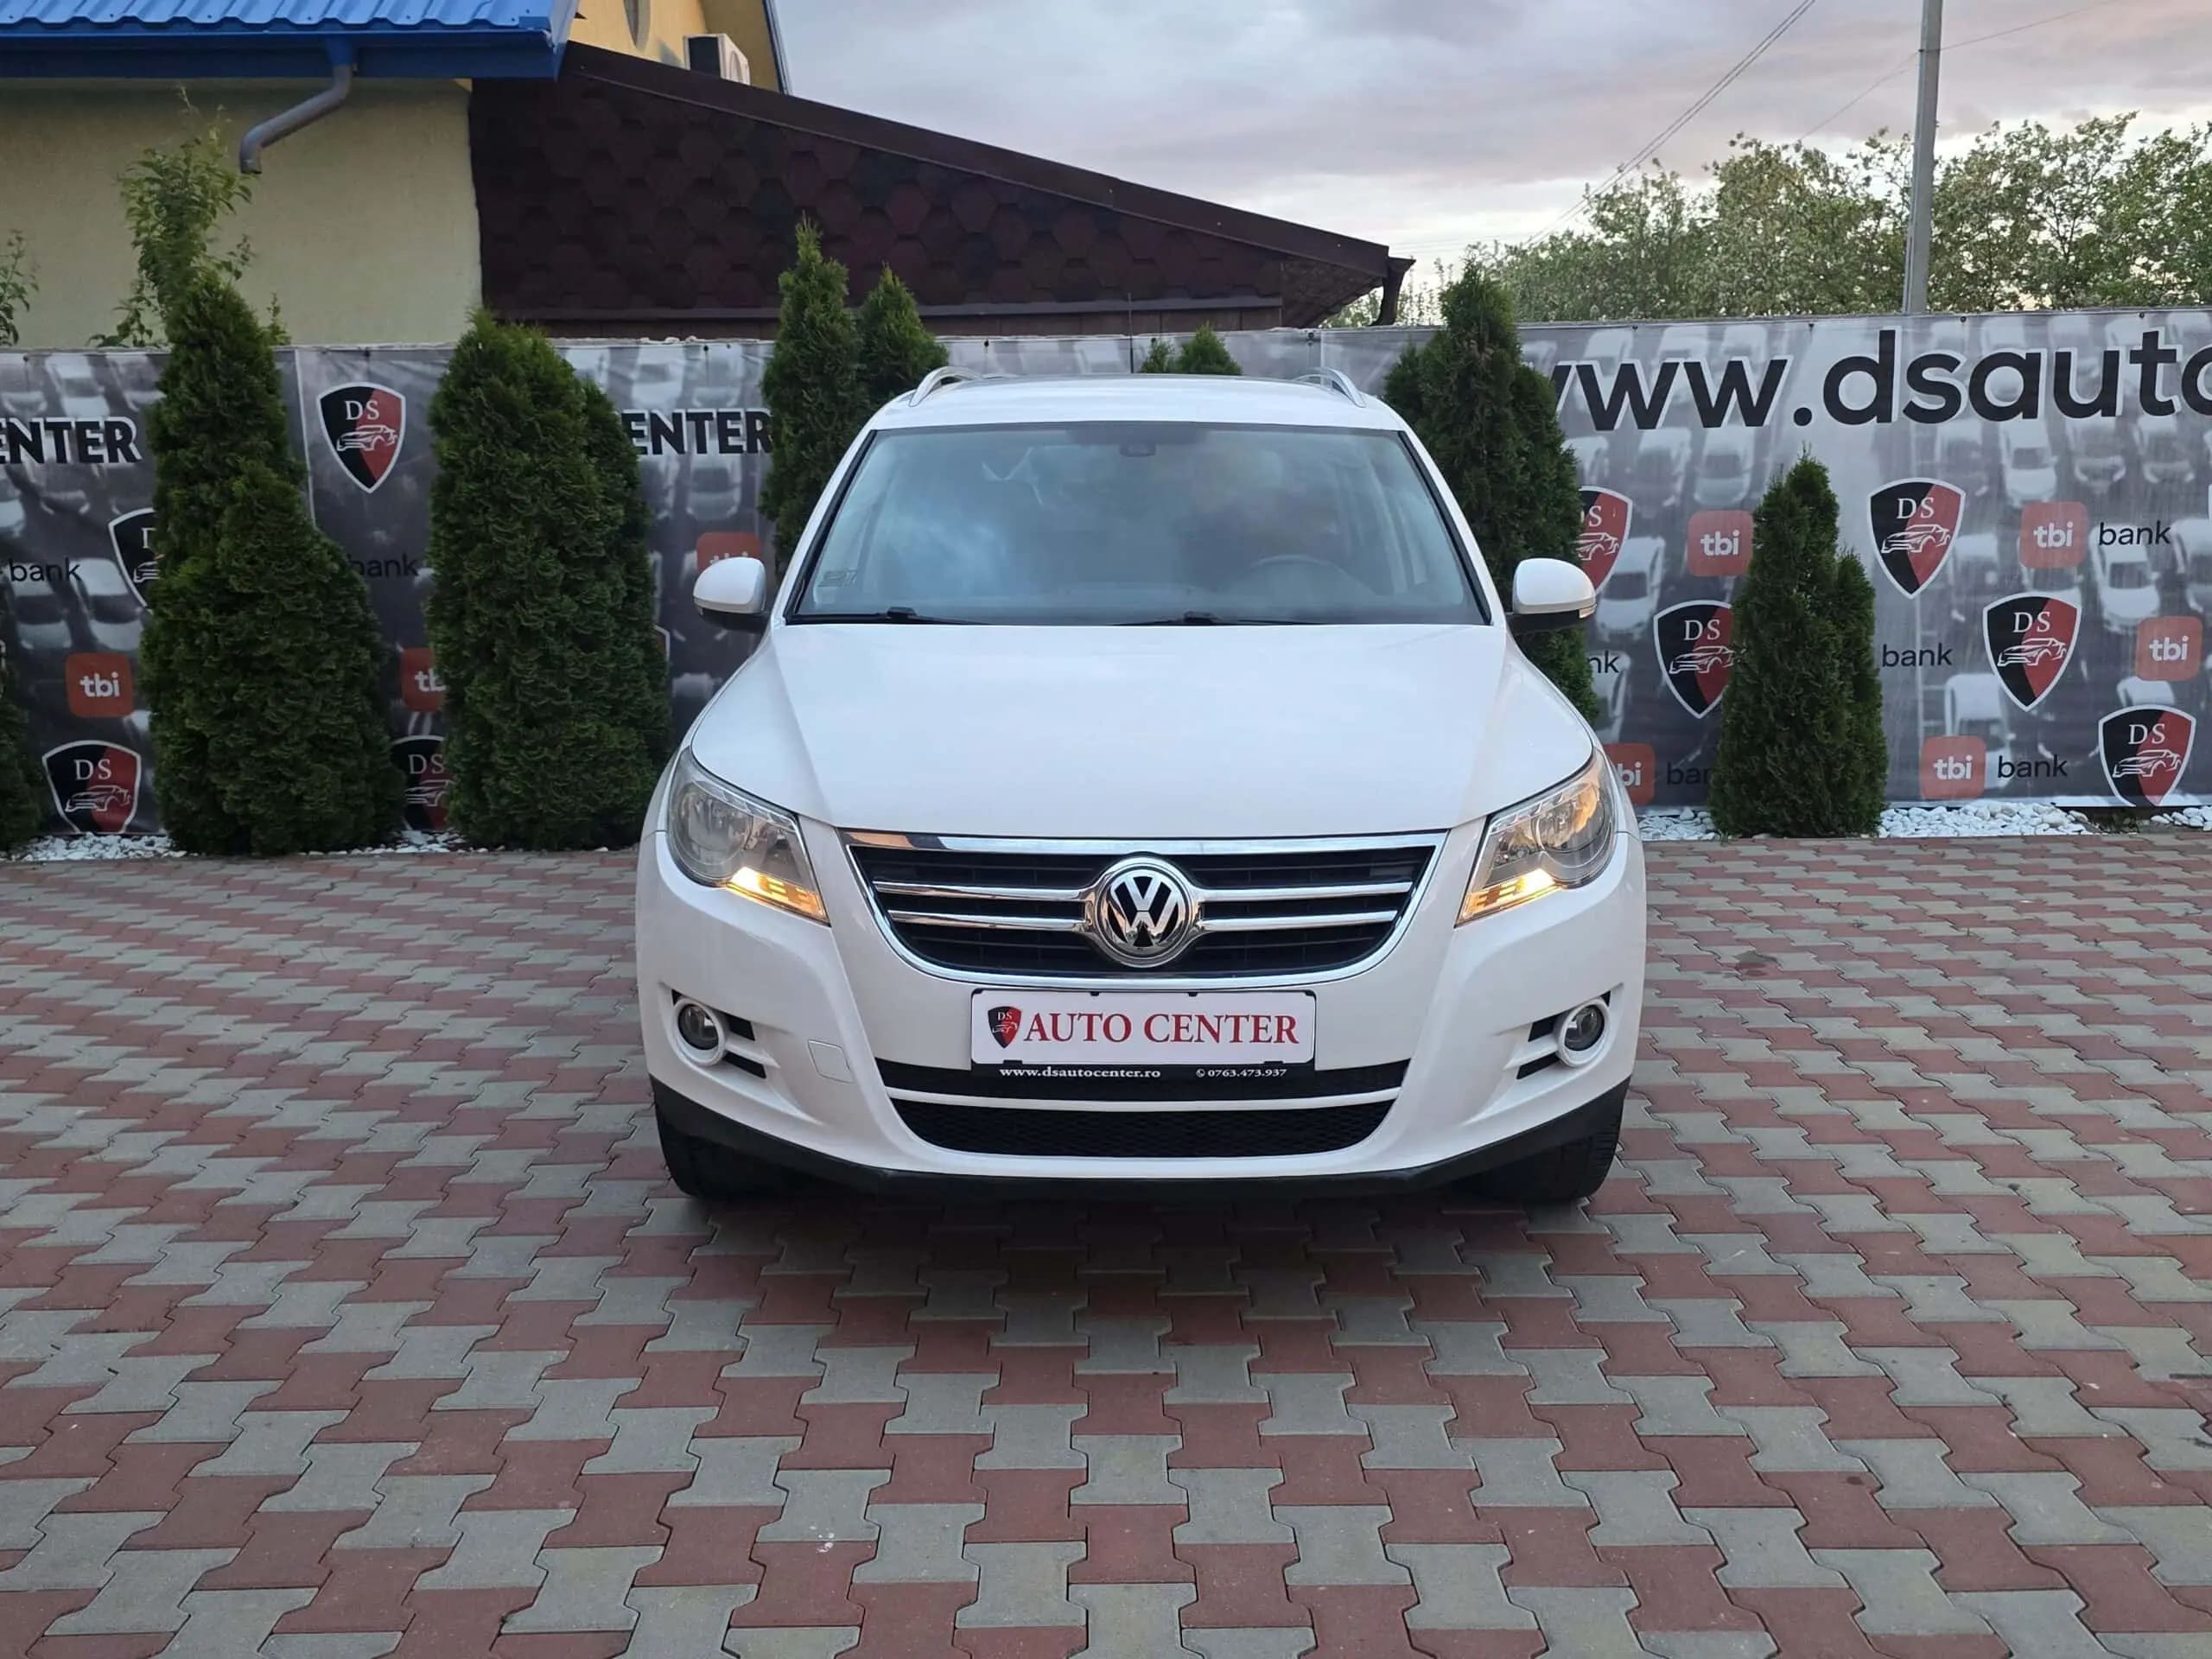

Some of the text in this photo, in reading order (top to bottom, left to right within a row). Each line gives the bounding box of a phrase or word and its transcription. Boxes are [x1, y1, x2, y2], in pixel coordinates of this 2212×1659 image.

[344, 400, 380, 421] DS
[0, 417, 141, 464] NTER
[1896, 497, 1936, 519] DS
[1700, 529, 1740, 556] tbi
[2033, 520, 2171, 549] tbi bank
[9, 557, 83, 582] bank
[1683, 619, 1721, 641] DS
[2012, 611, 2051, 633] DS
[1881, 643, 1954, 668] bank
[2149, 635, 2189, 662] tbi
[1587, 650, 1621, 674] nk
[79, 671, 120, 697] tbi
[415, 667, 447, 692] tb
[2128, 723, 2166, 745] DS
[74, 759, 112, 780] DS
[408, 753, 444, 774] DS
[1618, 761, 1642, 786] bi
[1933, 754, 2069, 779] tbi bank
[997, 1011, 1013, 1020] DS
[1023, 1013, 1300, 1045] AUTO CENTER
[999, 1066, 1161, 1078] www.dsautocenter.ro
[1207, 1069, 1287, 1077] 0763.473.937
